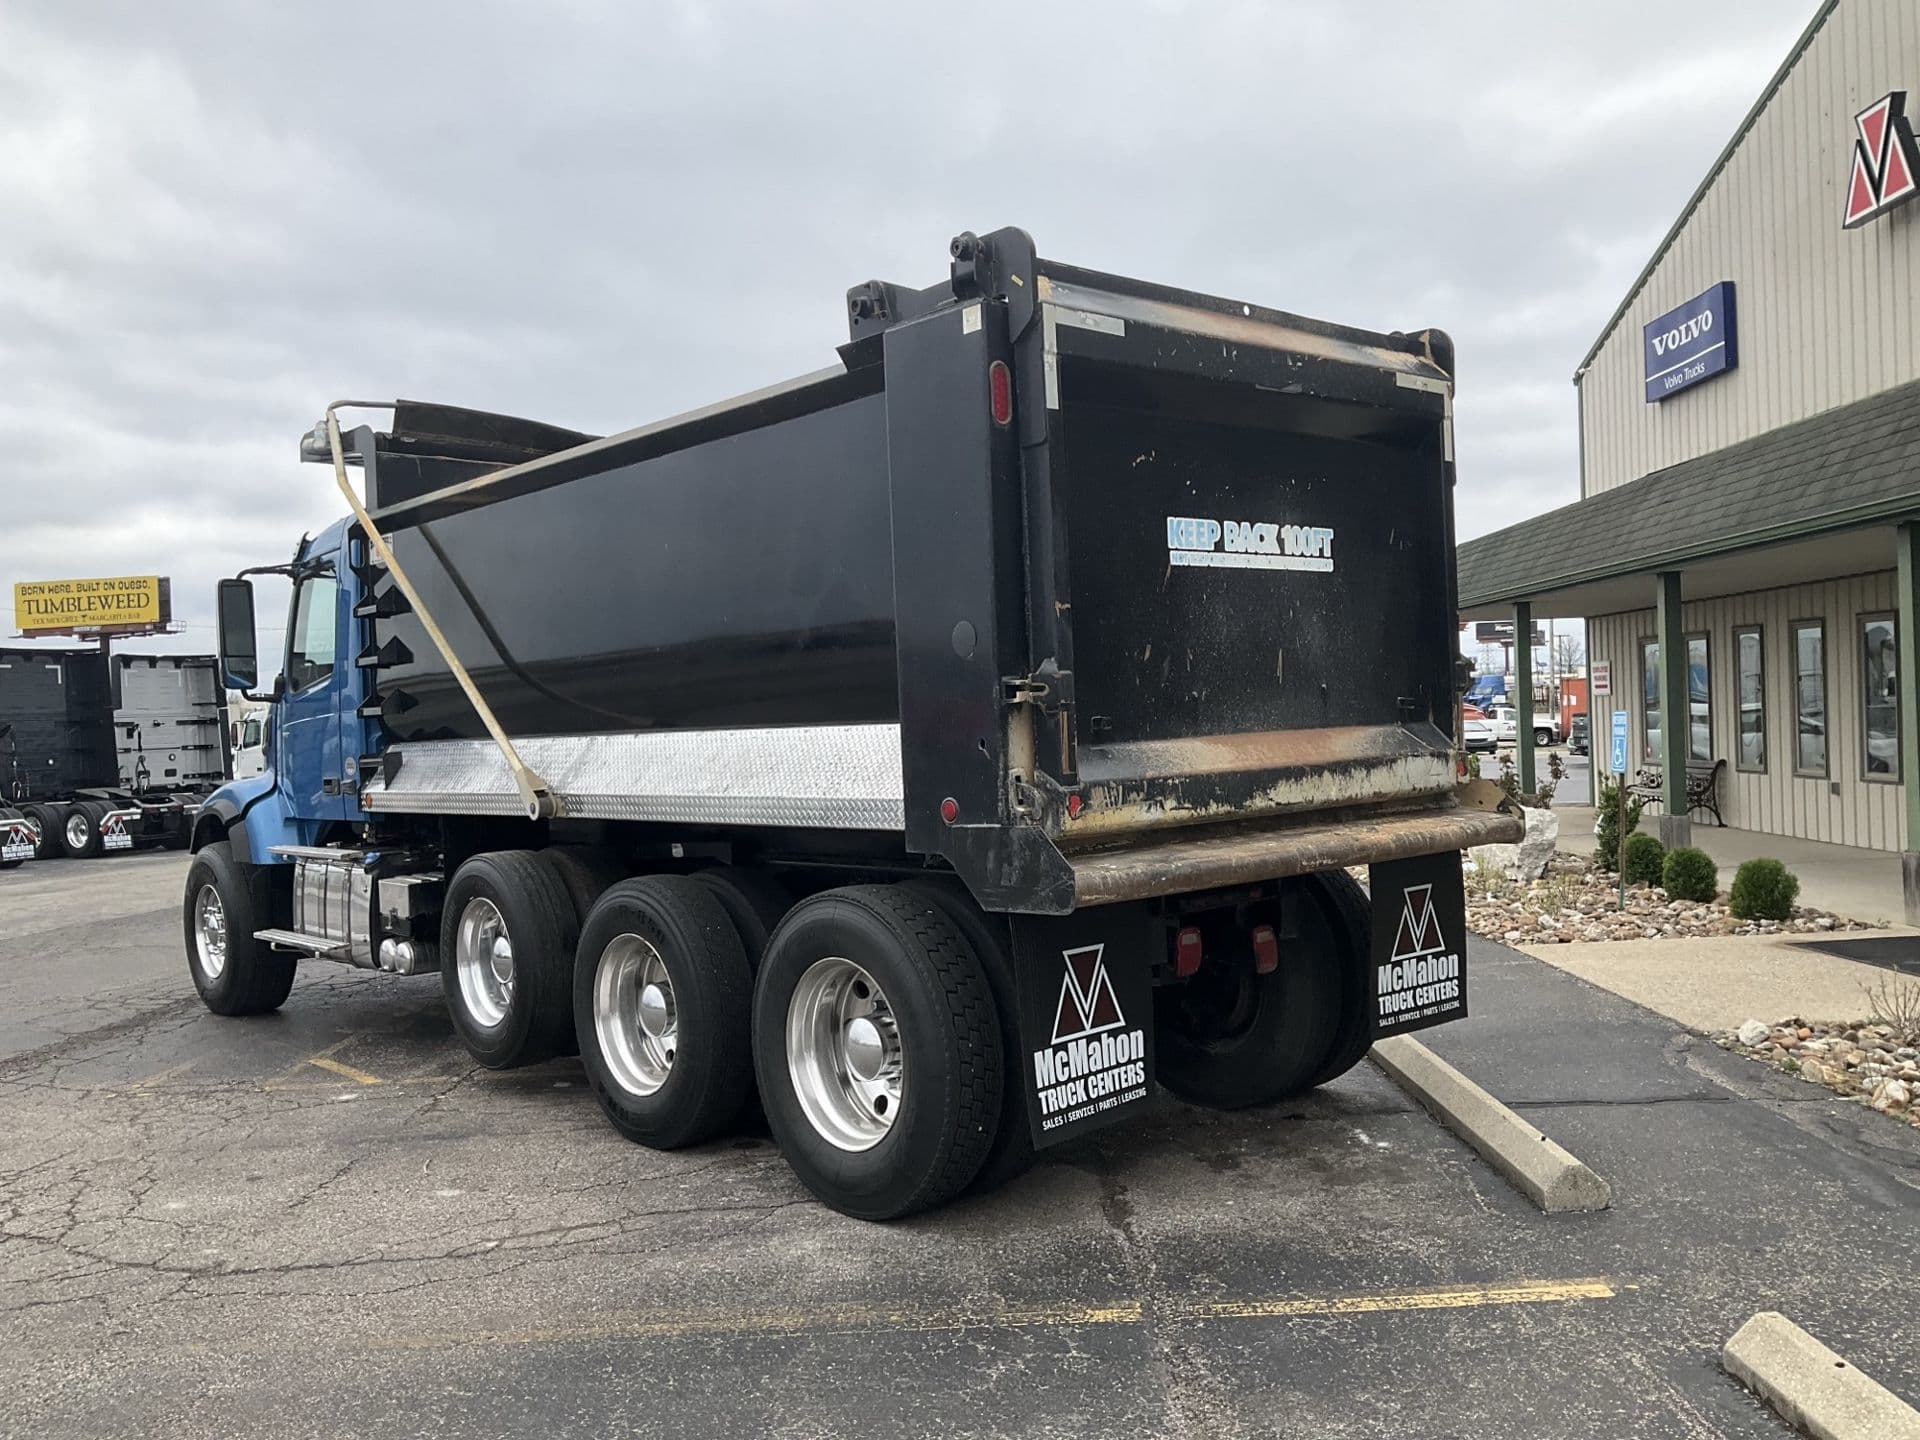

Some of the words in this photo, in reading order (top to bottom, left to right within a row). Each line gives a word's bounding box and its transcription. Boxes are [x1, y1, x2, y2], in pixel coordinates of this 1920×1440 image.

[1651, 310, 1713, 356] VOLVO
[1664, 374, 1683, 389] Volvo
[1684, 362, 1705, 380] Trucks
[1167, 517, 1221, 550] KEEP
[1224, 520, 1281, 554] BACK
[1281, 524, 1334, 557] 100FT
[21, 586, 45, 596] BORN
[103, 581, 115, 591] ON
[23, 593, 150, 615] TUMBLEWEED
[1378, 954, 1459, 995] McMahon
[1378, 990, 1416, 1015] TRUCK
[1415, 979, 1459, 1006] CENTERS
[1033, 1029, 1145, 1089] McMahon
[1038, 1077, 1088, 1115] TRUCK
[1087, 1061, 1145, 1100] CENTERS
[1042, 1115, 1063, 1131] SALES
[1068, 1105, 1095, 1122] SERVICE
[1099, 1097, 1118, 1112] PARTS
[1121, 1087, 1147, 1103] LEASING
